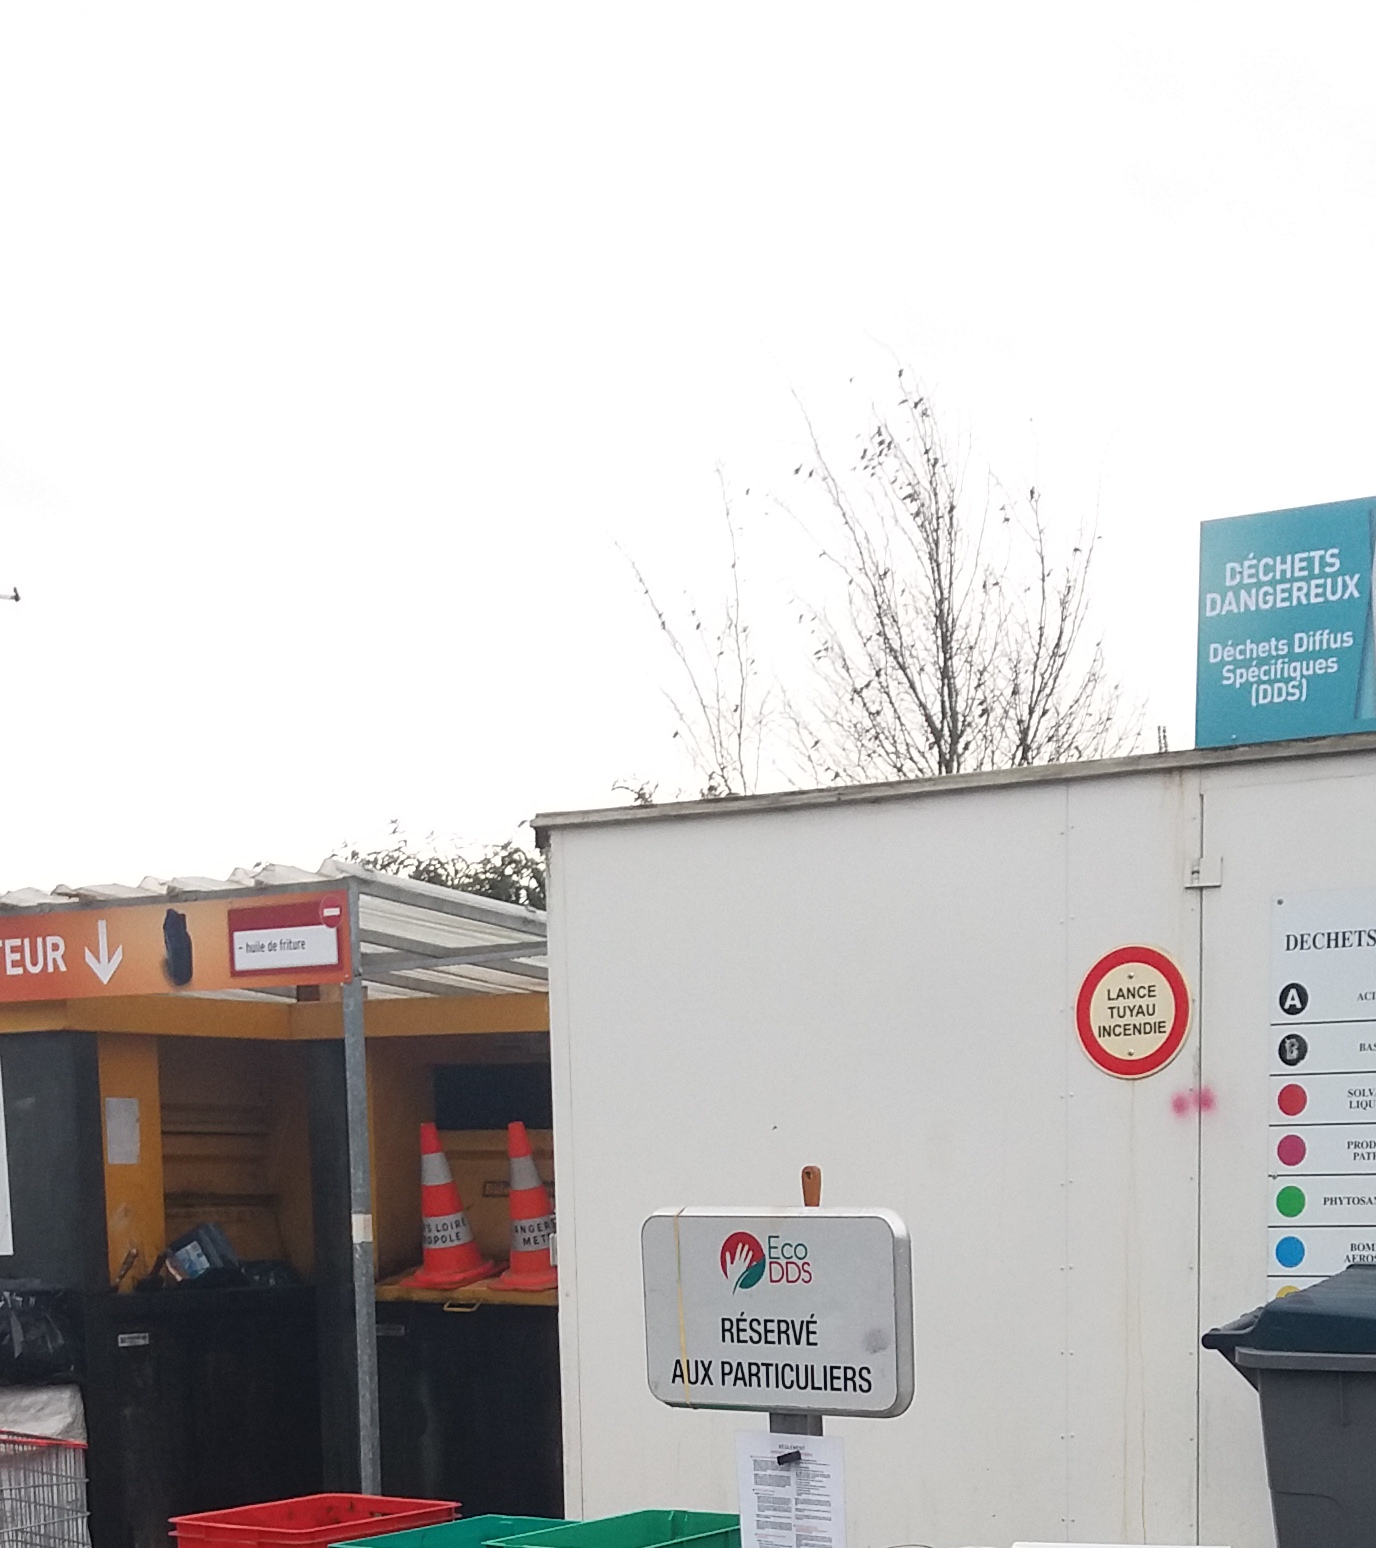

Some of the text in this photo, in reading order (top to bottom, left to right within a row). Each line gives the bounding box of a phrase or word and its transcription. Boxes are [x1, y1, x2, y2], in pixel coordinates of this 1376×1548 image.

[1225, 548, 1341, 587] DÉCHETS
[1205, 573, 1361, 617] DANGEREUX
[1209, 629, 1354, 663] Déchets Diffus
[1222, 657, 1338, 688] Spécifiques
[1251, 678, 1307, 707] (DDS)
[246, 939, 306, 953] huile de friture
[1285, 929, 1376, 952] DECHETS
[1107, 985, 1157, 1001] LANCE
[1107, 1003, 1156, 1019] TUYAU
[1098, 1021, 1167, 1038] INCENDIE
[769, 1261, 812, 1284] DDS
[721, 1311, 818, 1346] RÉSERVÉ
[671, 1359, 872, 1393] AUX PARTICULIERS
